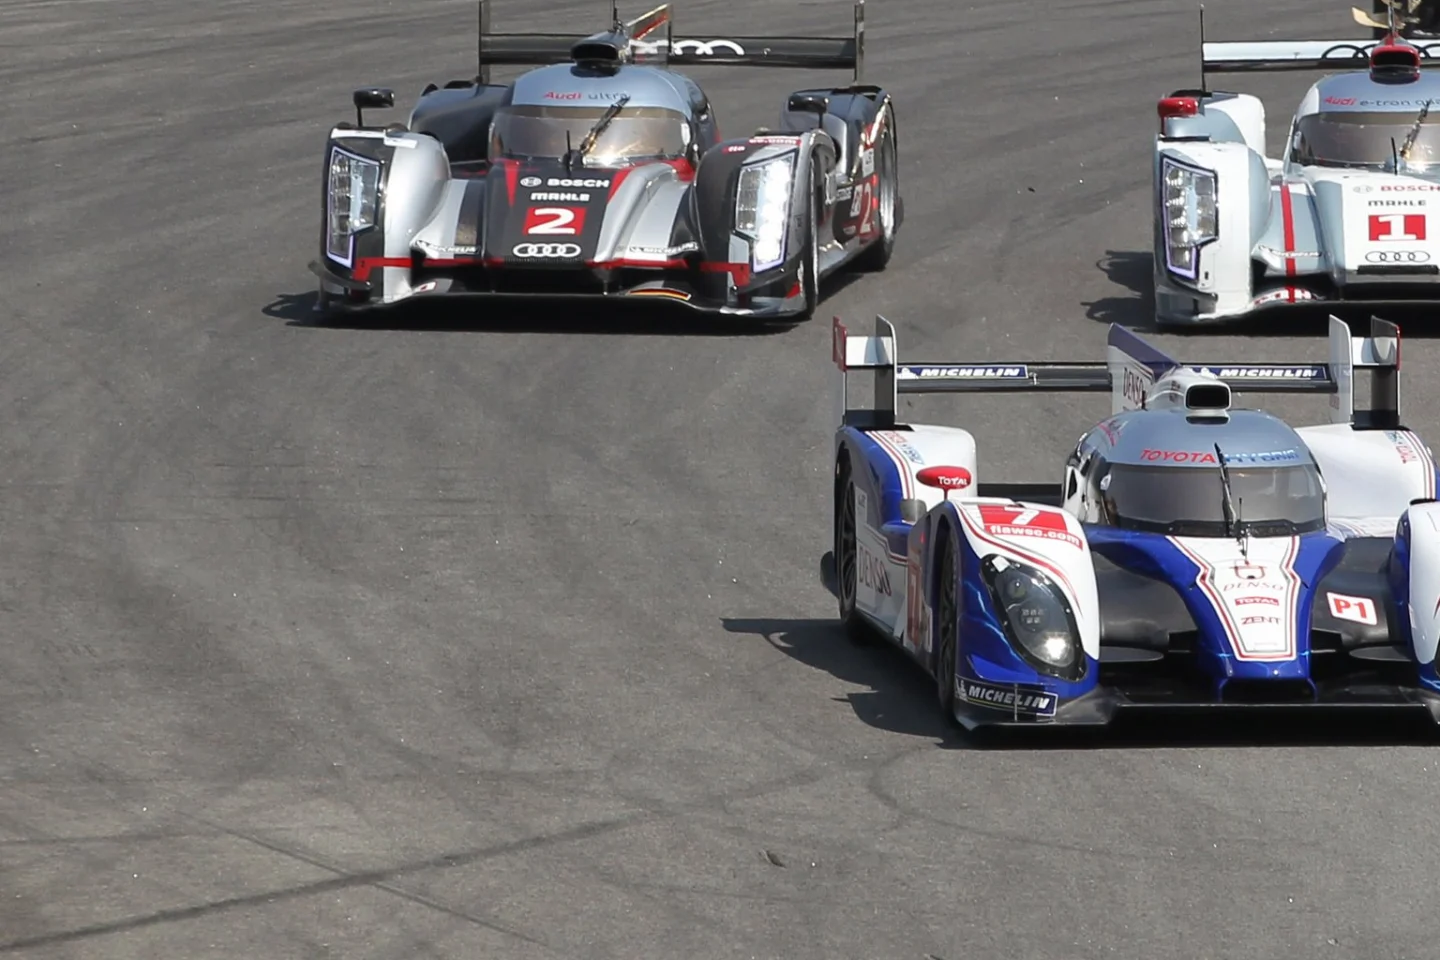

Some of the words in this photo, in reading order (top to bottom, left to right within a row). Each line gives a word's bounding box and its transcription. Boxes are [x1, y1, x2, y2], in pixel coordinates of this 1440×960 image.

[544, 91, 582, 100] Audi
[1324, 95, 1357, 106] Audi
[1360, 98, 1411, 106] e-tron
[547, 178, 610, 188] BOSCH
[530, 192, 591, 202] MAHLE
[528, 207, 576, 235] 2
[1378, 214, 1418, 241] 1
[920, 368, 1020, 378] MICHELIN
[1220, 368, 1318, 378] MICHELIN
[1123, 367, 1144, 406] DENSO
[1140, 449, 1217, 464] TOYOTA
[938, 476, 968, 486] TOTAL
[1004, 506, 1041, 526] 7
[858, 546, 892, 597] DENSO
[1223, 581, 1284, 592] DENSO
[1236, 598, 1279, 606] TOTAL
[1333, 597, 1368, 619] P1
[1241, 615, 1281, 626] ZENT
[968, 685, 1050, 710] MICHELIN
